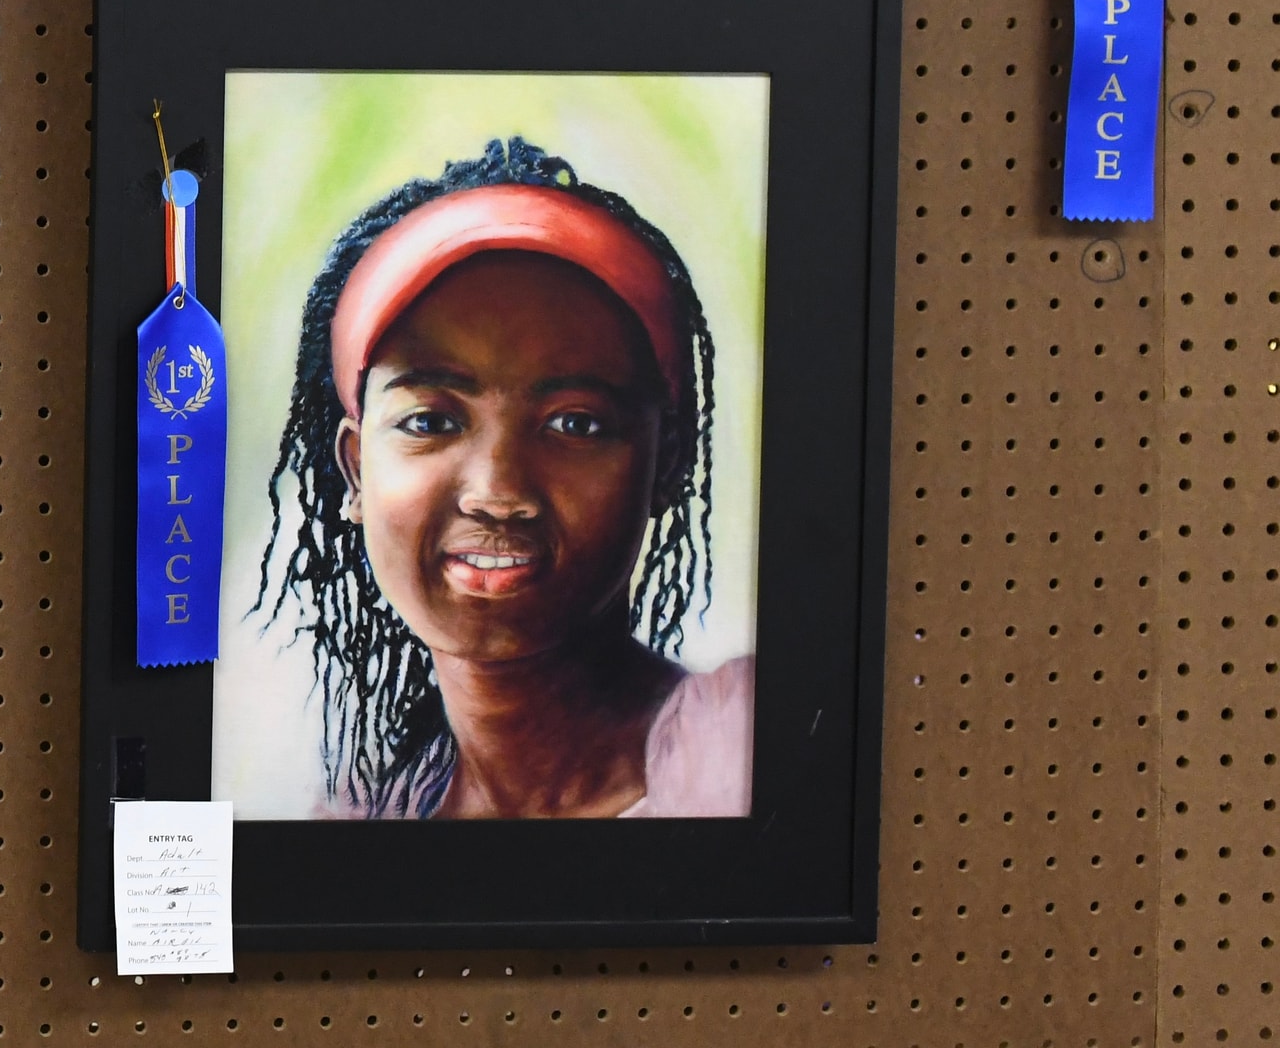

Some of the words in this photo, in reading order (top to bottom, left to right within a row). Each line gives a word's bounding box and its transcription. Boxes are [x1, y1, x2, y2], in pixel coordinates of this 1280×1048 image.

[165, 359, 194, 394] 1st
[164, 434, 193, 625] PLACE
[148, 835, 175, 843] ENTRY
[177, 835, 194, 843] TAG
